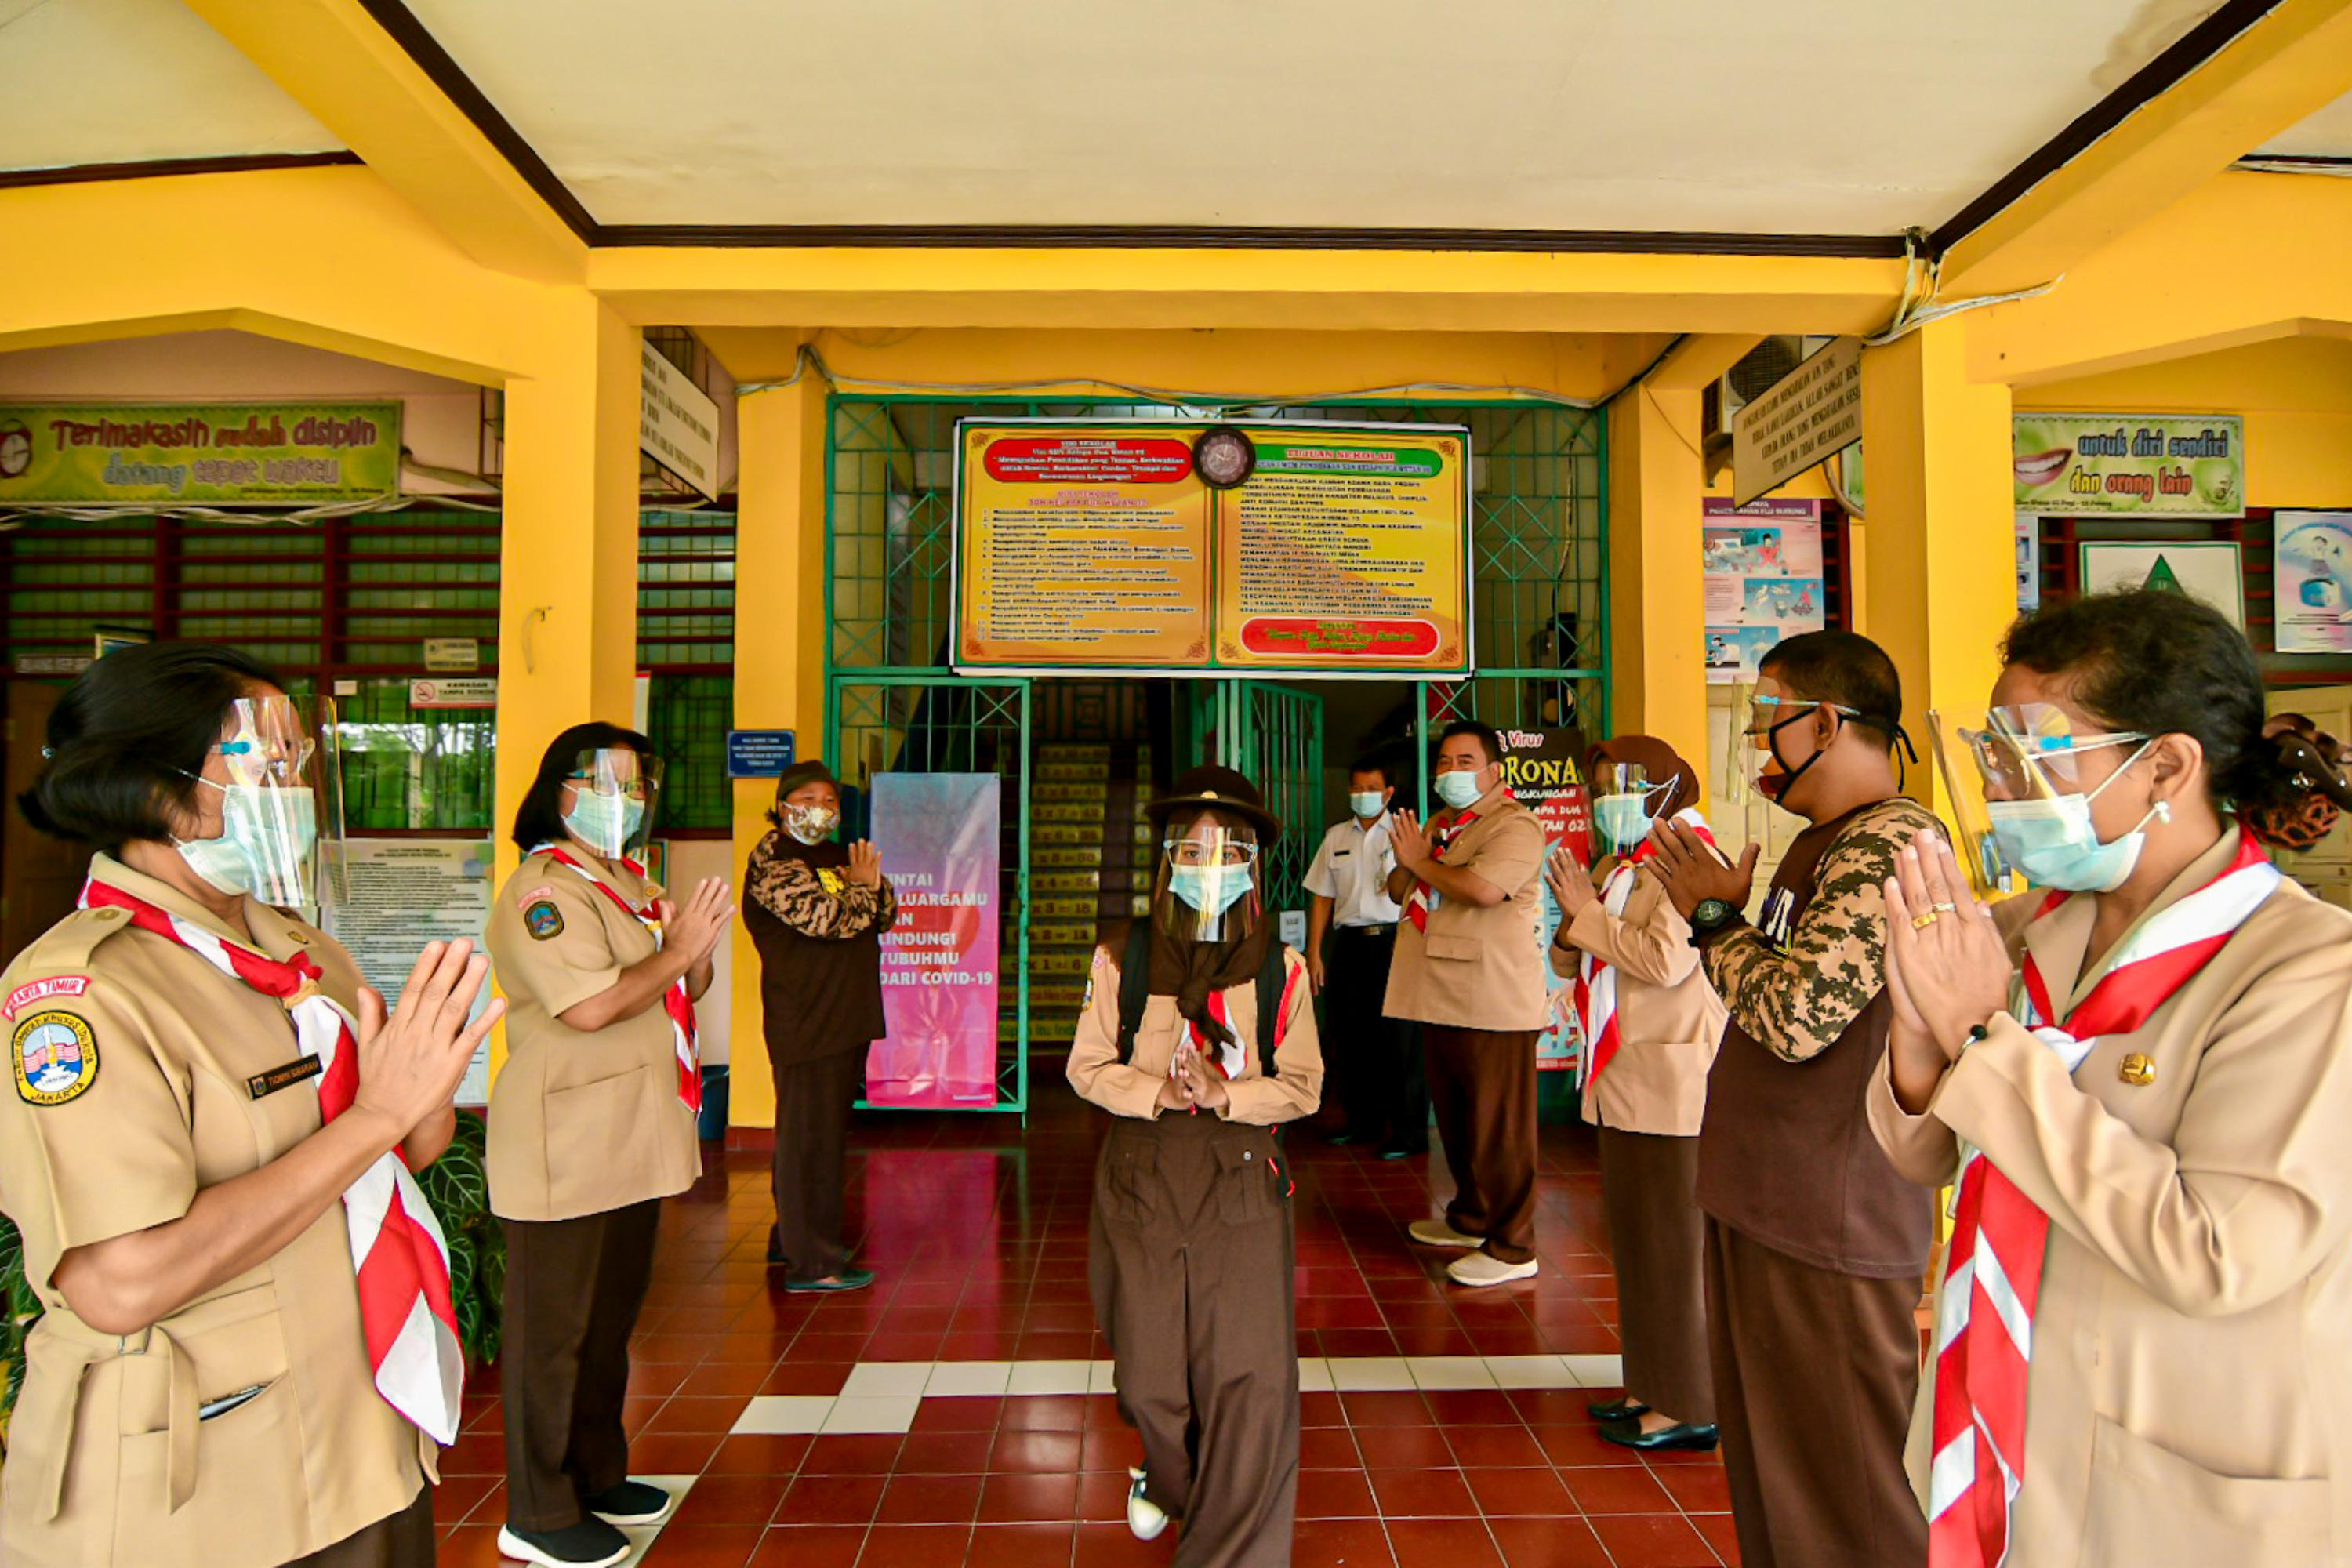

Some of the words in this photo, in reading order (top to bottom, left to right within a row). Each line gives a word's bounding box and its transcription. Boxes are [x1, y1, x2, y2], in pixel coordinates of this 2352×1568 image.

[49, 416, 209, 451] Terimakasih
[214, 414, 287, 448] sudah
[292, 416, 377, 449] disiplin
[2078, 427, 2128, 457] untuk
[2132, 427, 2165, 457] diri
[2168, 430, 2229, 459] sendiri
[1286, 448, 1334, 459] TUJUAN
[1335, 450, 1395, 461] SEKOLAH
[101, 451, 186, 495] datang
[191, 457, 260, 487] tepat
[263, 456, 341, 485] waktu
[2070, 464, 2102, 494] dan
[2105, 473, 2154, 503] orang
[2158, 465, 2193, 495] lain
[1506, 729, 1544, 748] Virus
[1499, 755, 1579, 786] RONA
[1559, 805, 1581, 815] DUA
[1541, 819, 1566, 831] TAN
[896, 892, 989, 907] LUARGAMU
[877, 931, 957, 946] LINDUNGI
[880, 952, 960, 966] TUBUHMU
[879, 971, 916, 985] DARI
[920, 971, 993, 986] COVID-19
[30, 1081, 86, 1102] JAKARTA
